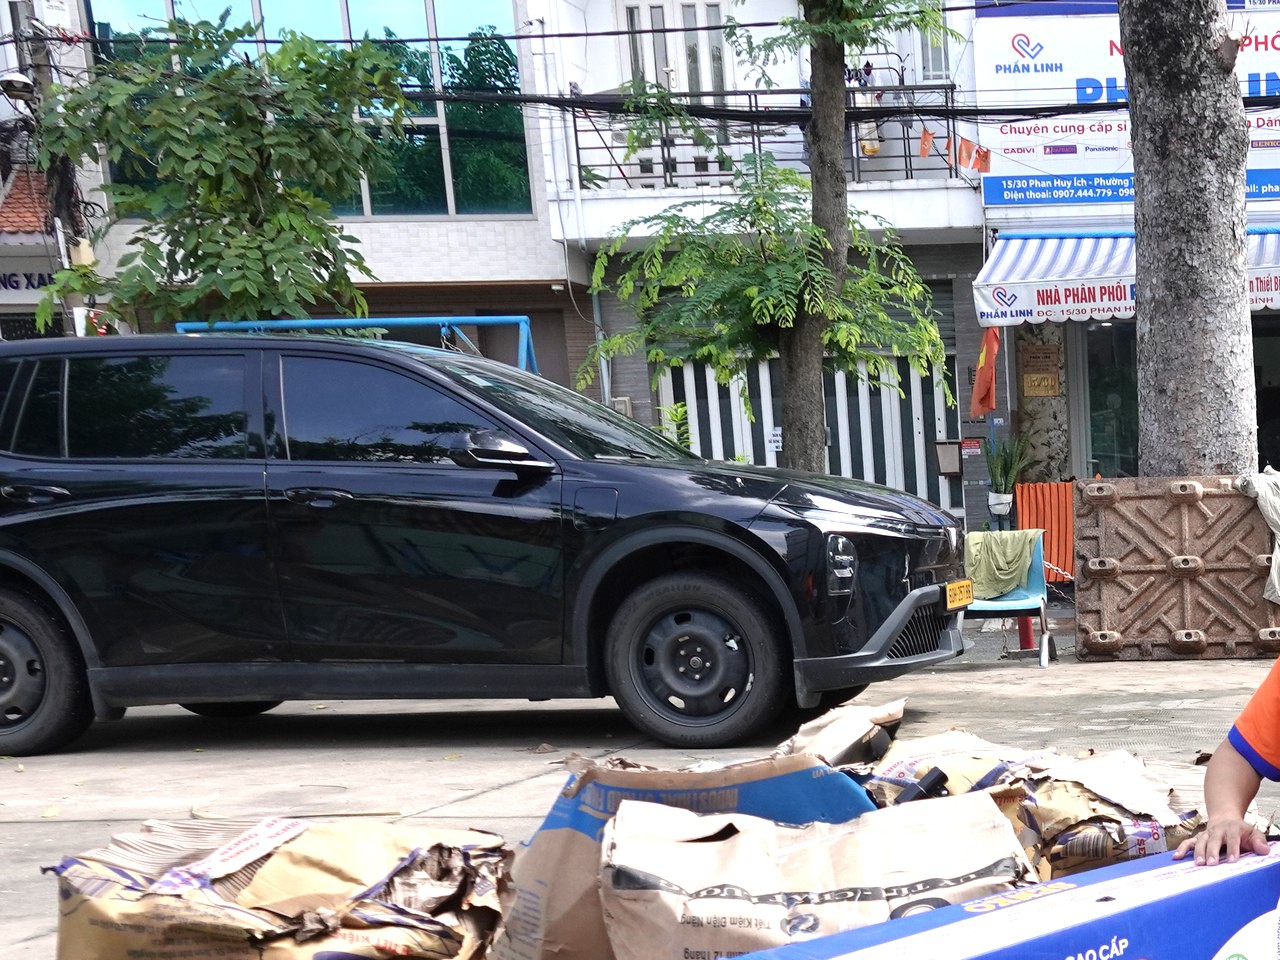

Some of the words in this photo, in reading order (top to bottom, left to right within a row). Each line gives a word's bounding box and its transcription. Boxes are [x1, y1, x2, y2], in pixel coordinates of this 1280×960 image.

[995, 60, 1030, 74] PHẤN
[1034, 63, 1063, 73] LINH
[1000, 123, 1049, 136] Chuyên
[1053, 125, 1085, 135] cung
[1089, 120, 1113, 133] cấp
[1002, 179, 1027, 189] 15/30
[1029, 178, 1051, 188] Phan
[1054, 179, 1071, 189] Huy
[1074, 176, 1087, 187] Ích
[1094, 177, 1129, 188] Phường
[1004, 190, 1024, 201] Điện
[1053, 188, 1112, 199] 0907.444.779
[1255, 272, 1273, 293] Thiết
[1036, 284, 1061, 306] NHÀ
[1064, 283, 1096, 304] PHÂN
[1100, 279, 1127, 303] PHỐI
[980, 308, 1007, 319] PHẤN
[1010, 309, 1033, 318] LINH
[1060, 308, 1087, 316] 15/30
[1090, 306, 1121, 314] PHAN
[963, 881, 1077, 913] SENKO
[706, 914, 728, 931] Điện
[729, 914, 752, 930] Kiệm
